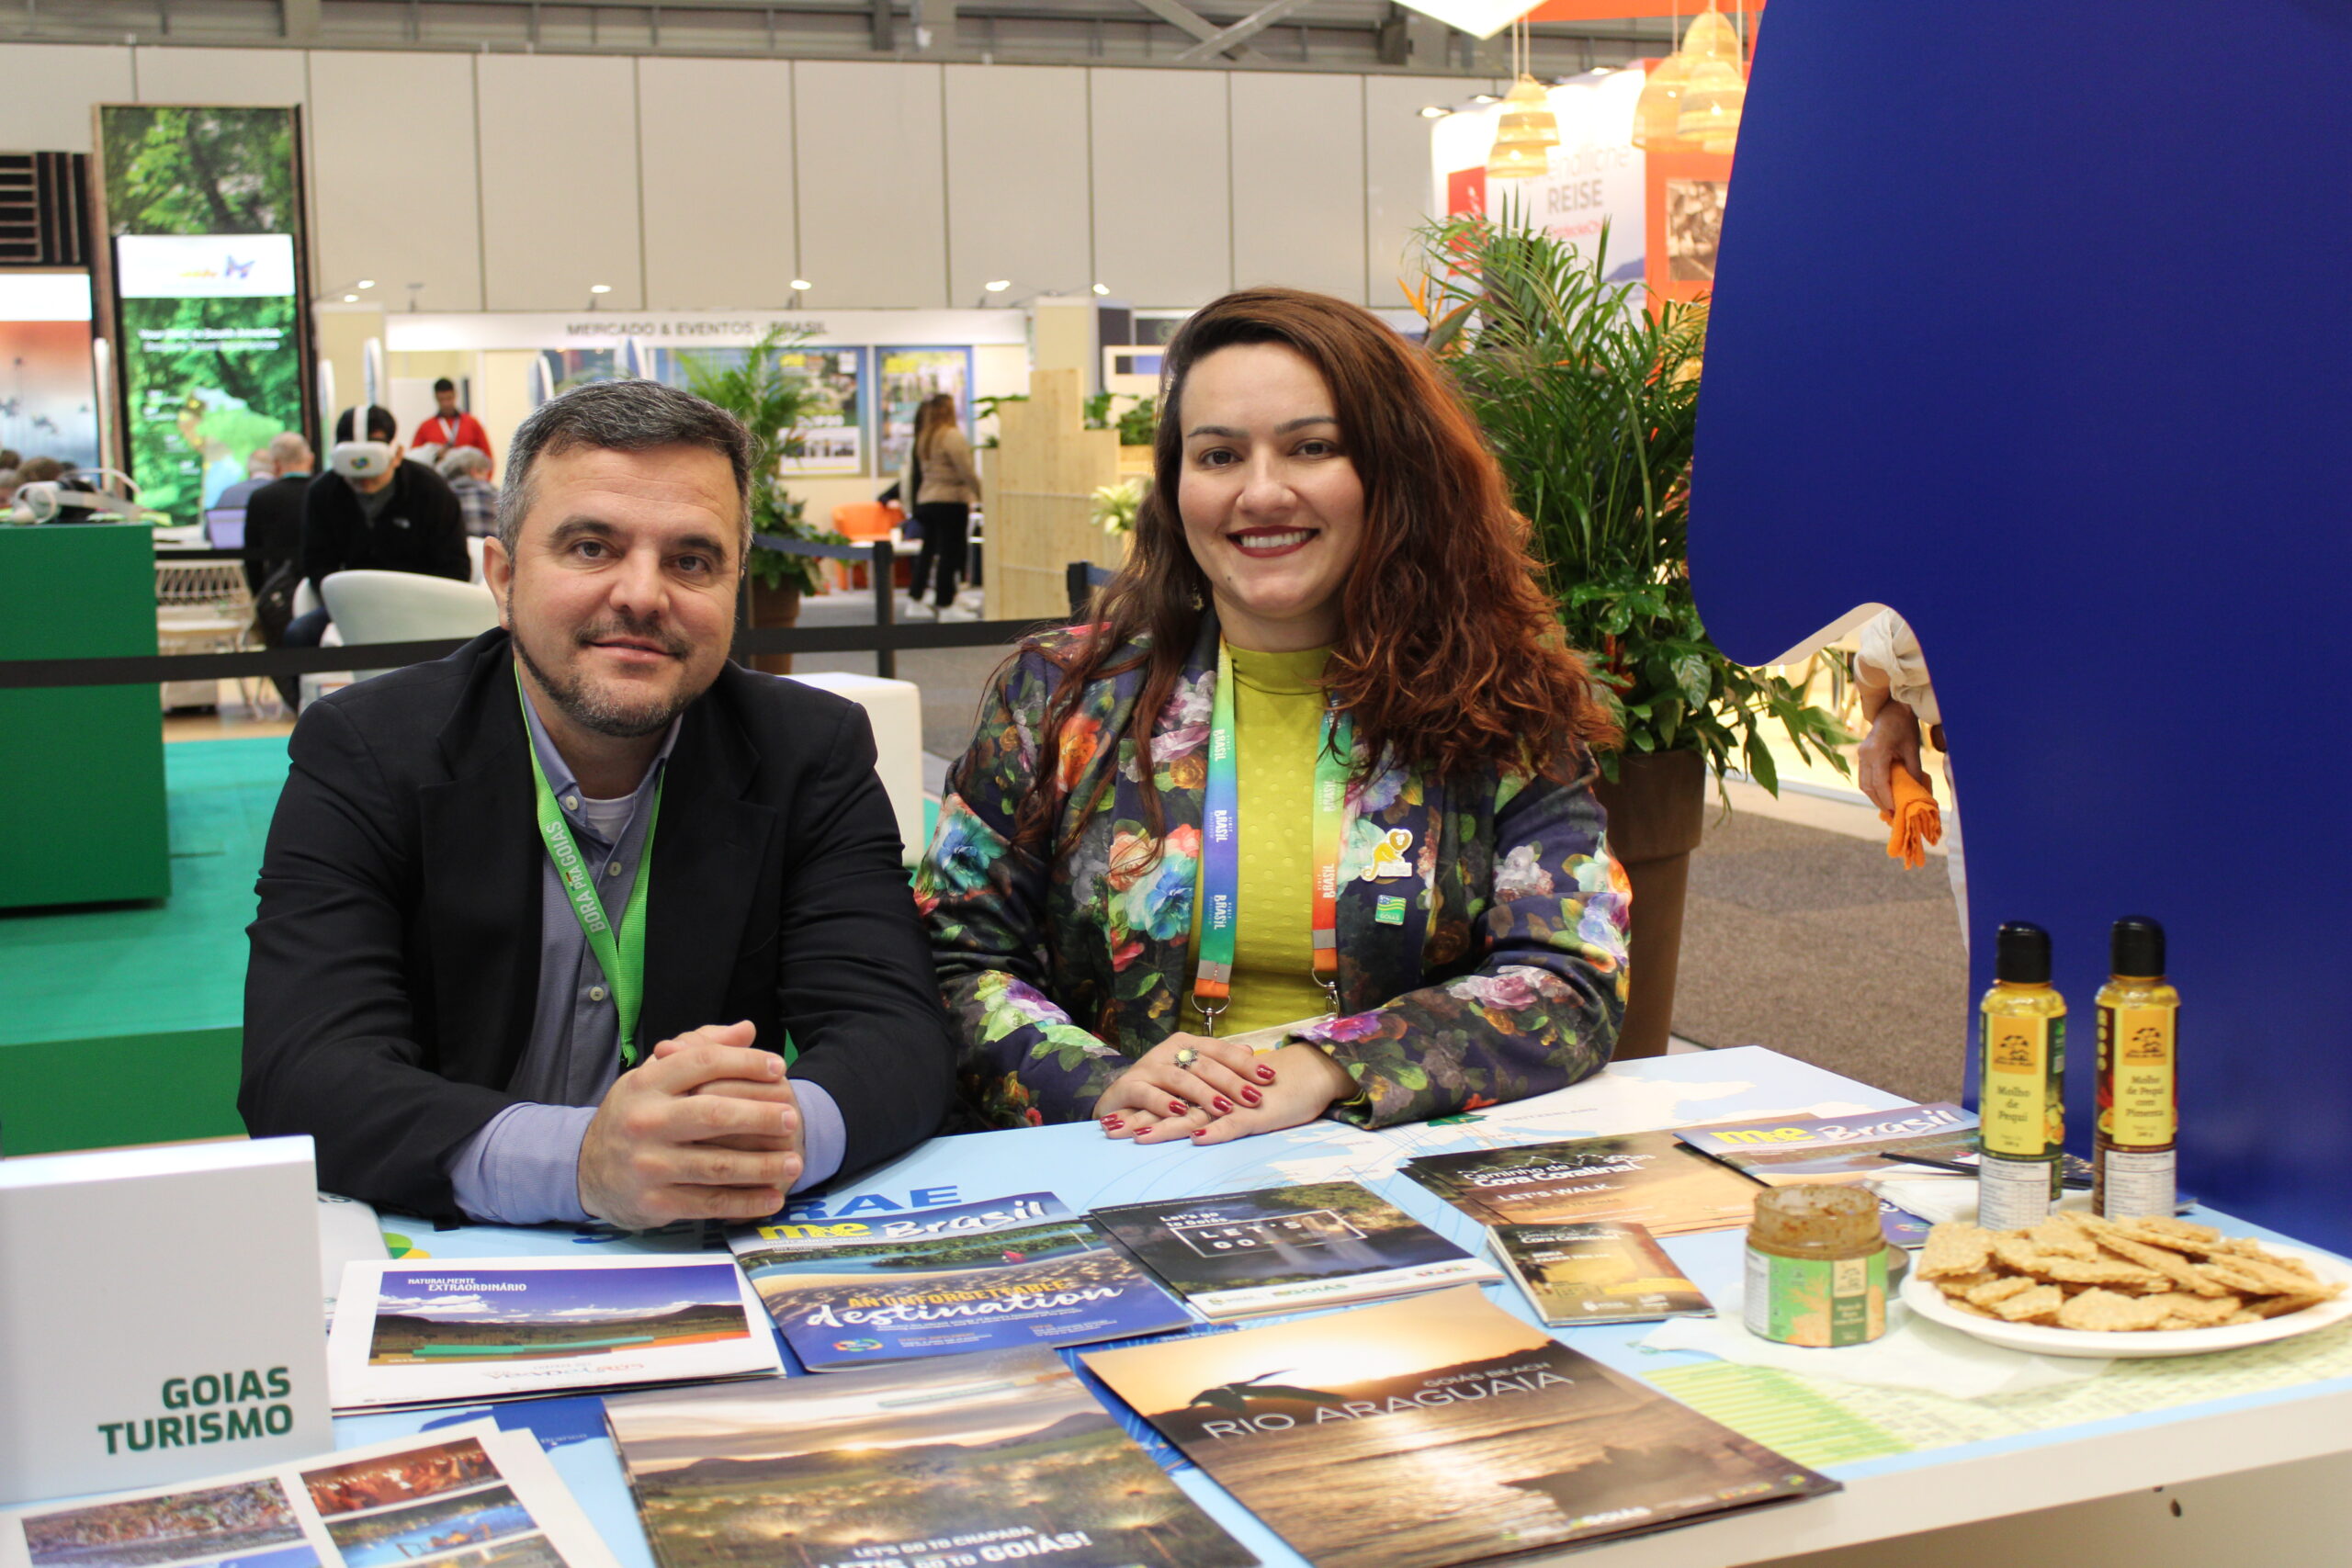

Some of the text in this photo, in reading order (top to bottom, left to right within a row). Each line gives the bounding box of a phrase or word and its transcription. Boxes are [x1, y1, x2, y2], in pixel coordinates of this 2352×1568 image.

[1547, 179, 1603, 214] REISE
[566, 322, 653, 336] MERCADO
[677, 321, 752, 335] EVENTOS
[569, 864, 587, 890] PRA
[575, 890, 606, 933] BORA
[1996, 1085, 2031, 1098] Molho
[2126, 1086, 2138, 1095] de
[2131, 1075, 2161, 1085] Molho
[1997, 1110, 2029, 1123] Pequi
[2006, 1099, 2019, 1109] de
[1816, 1109, 1964, 1142] Brasil
[1464, 1163, 1570, 1180] Caminho de
[1473, 1160, 1646, 1188] Cora Coralina
[1498, 1190, 1552, 1202] LET'S
[881, 1200, 1047, 1239] Brasil
[1159, 1211, 1220, 1223] Let's go
[1200, 1220, 1303, 1240] LET'S
[1212, 1238, 1257, 1250] GO
[428, 1282, 527, 1292] EXTRAORDINÁRIO
[847, 1280, 1068, 1308] AN UNFORGETTABLE
[806, 1287, 1125, 1328] destination
[1422, 1361, 1552, 1388] GOIÁS BEACH
[162, 1366, 291, 1410] GOIAS
[1202, 1370, 1576, 1439] RIO ARAGUAIA
[97, 1404, 294, 1455] TURISMO
[852, 1544, 899, 1558] LET'S
[927, 1538, 953, 1550] TO
[953, 1526, 1036, 1546] CHAPADA
[978, 1529, 1094, 1563] GOIÁS!
